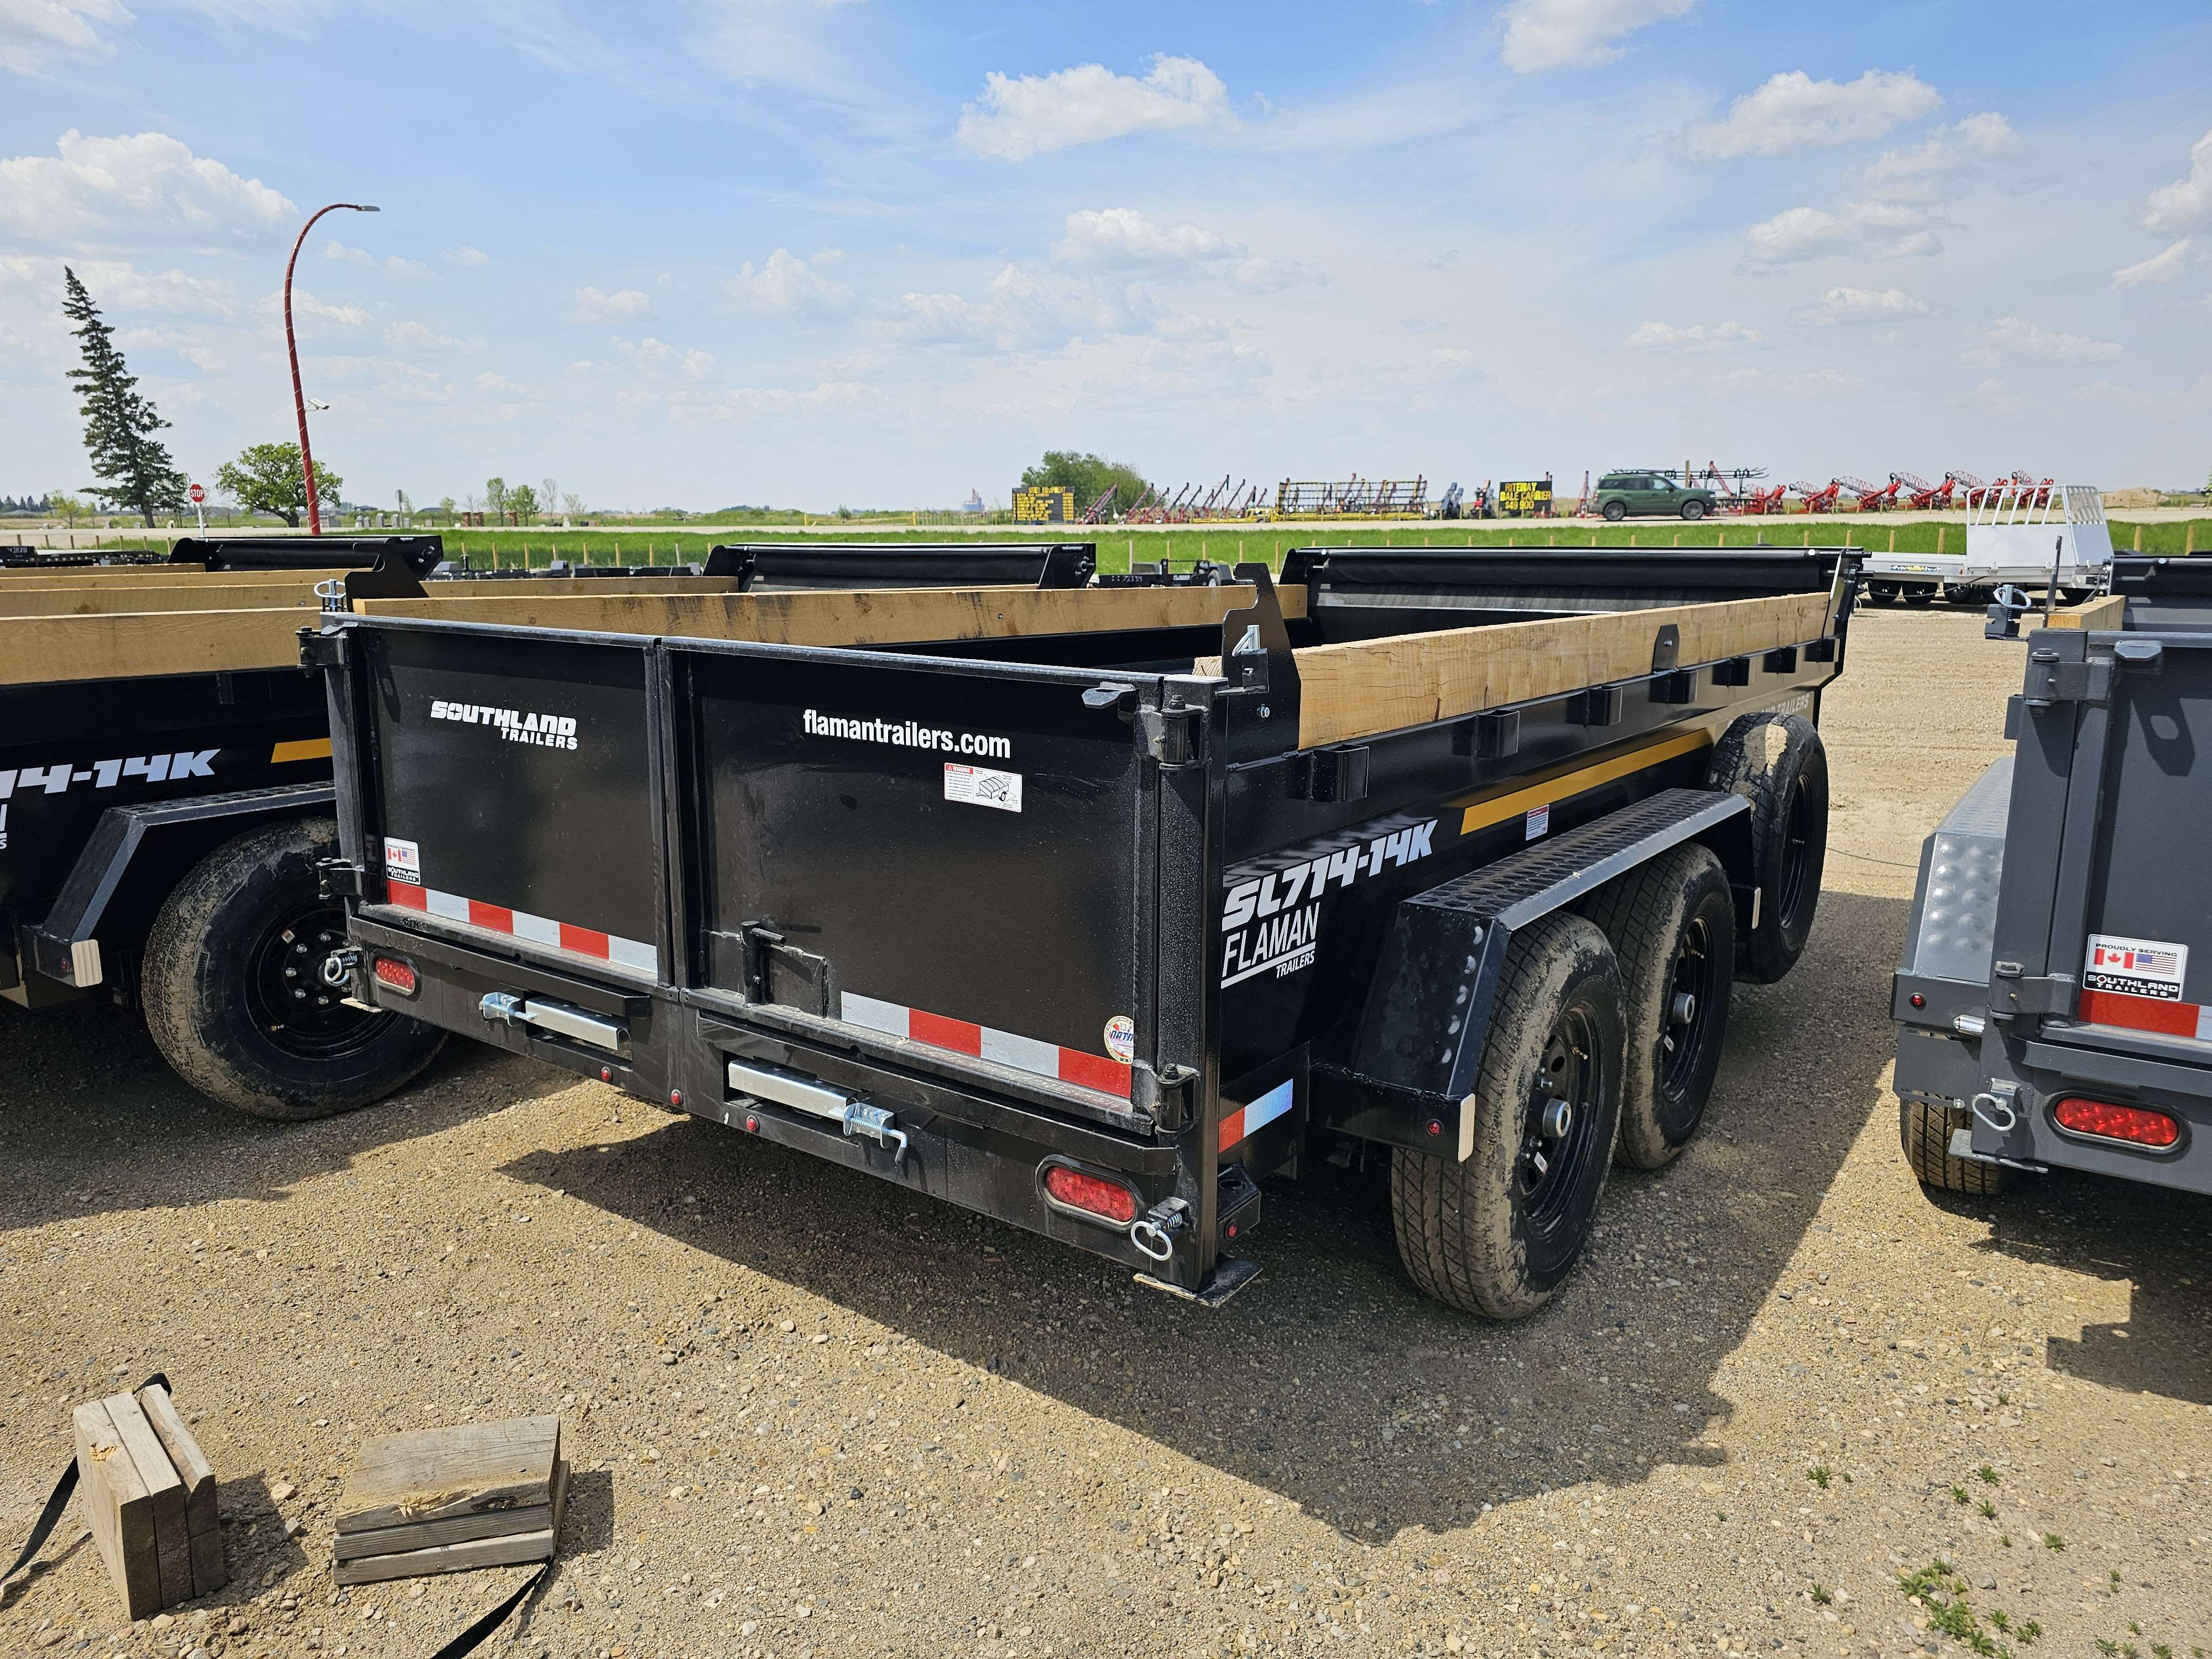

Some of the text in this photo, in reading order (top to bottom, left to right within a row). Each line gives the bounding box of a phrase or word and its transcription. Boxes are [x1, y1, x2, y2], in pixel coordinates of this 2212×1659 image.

[190, 489, 204, 498] STOP
[1500, 491, 1551, 501] BALE CARRIER
[1505, 482, 1537, 492] RITEWAY
[430, 700, 576, 737] SOUTHLAND
[500, 727, 578, 750] TRAILERS
[803, 709, 1011, 759] flamantrailers.com
[387, 867, 419, 878] SOUTHLAND
[1222, 819, 1438, 932] SL714-14K
[1222, 902, 1320, 978] FLAMAN
[2095, 943, 2177, 957] PROUDLY SERVING
[1276, 950, 1315, 979] TRAILERS
[2087, 974, 2179, 993] SOUTHLAND
[2096, 982, 2168, 997] TRAILERS
